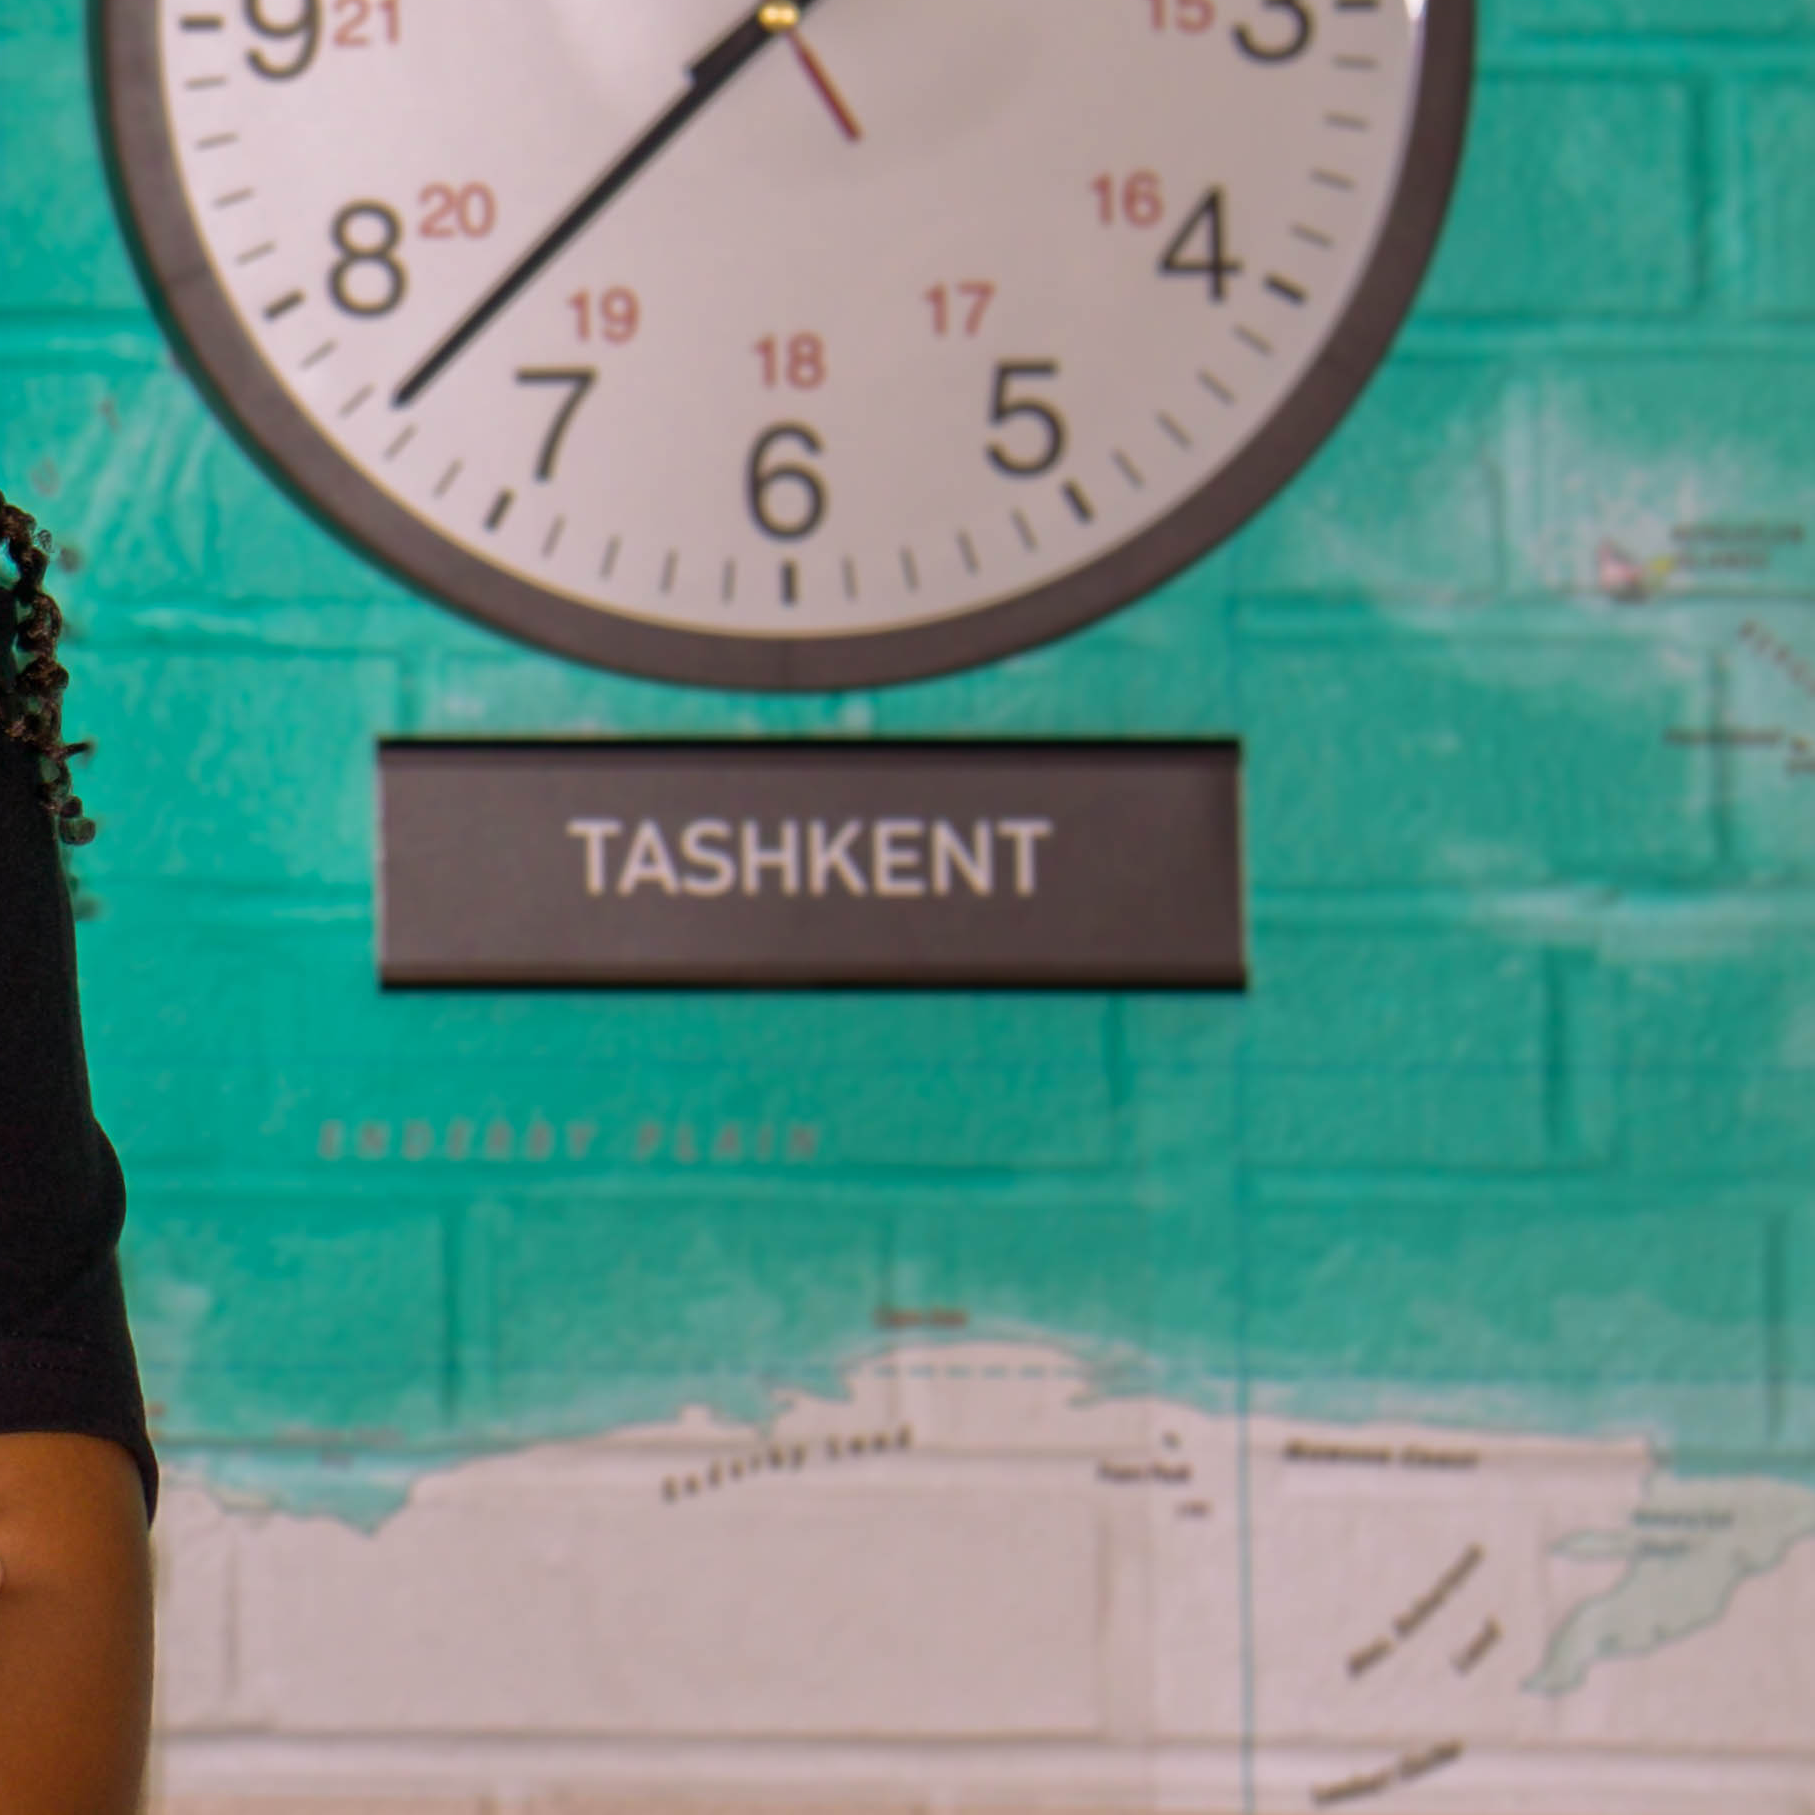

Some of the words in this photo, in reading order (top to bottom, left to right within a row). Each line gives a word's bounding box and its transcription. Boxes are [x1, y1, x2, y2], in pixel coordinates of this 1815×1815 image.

[418, 182, 496, 239] 20
[1092, 172, 1162, 227] 16
[326, 199, 408, 320] 8
[1158, 187, 1241, 302] 4
[570, 287, 640, 344] 19
[925, 280, 996, 335] 17
[755, 333, 826, 389] 18
[515, 366, 598, 483] 7
[986, 359, 1067, 479] 5
[745, 421, 828, 542] 6
[568, 818, 1052, 898] TASHKENT
